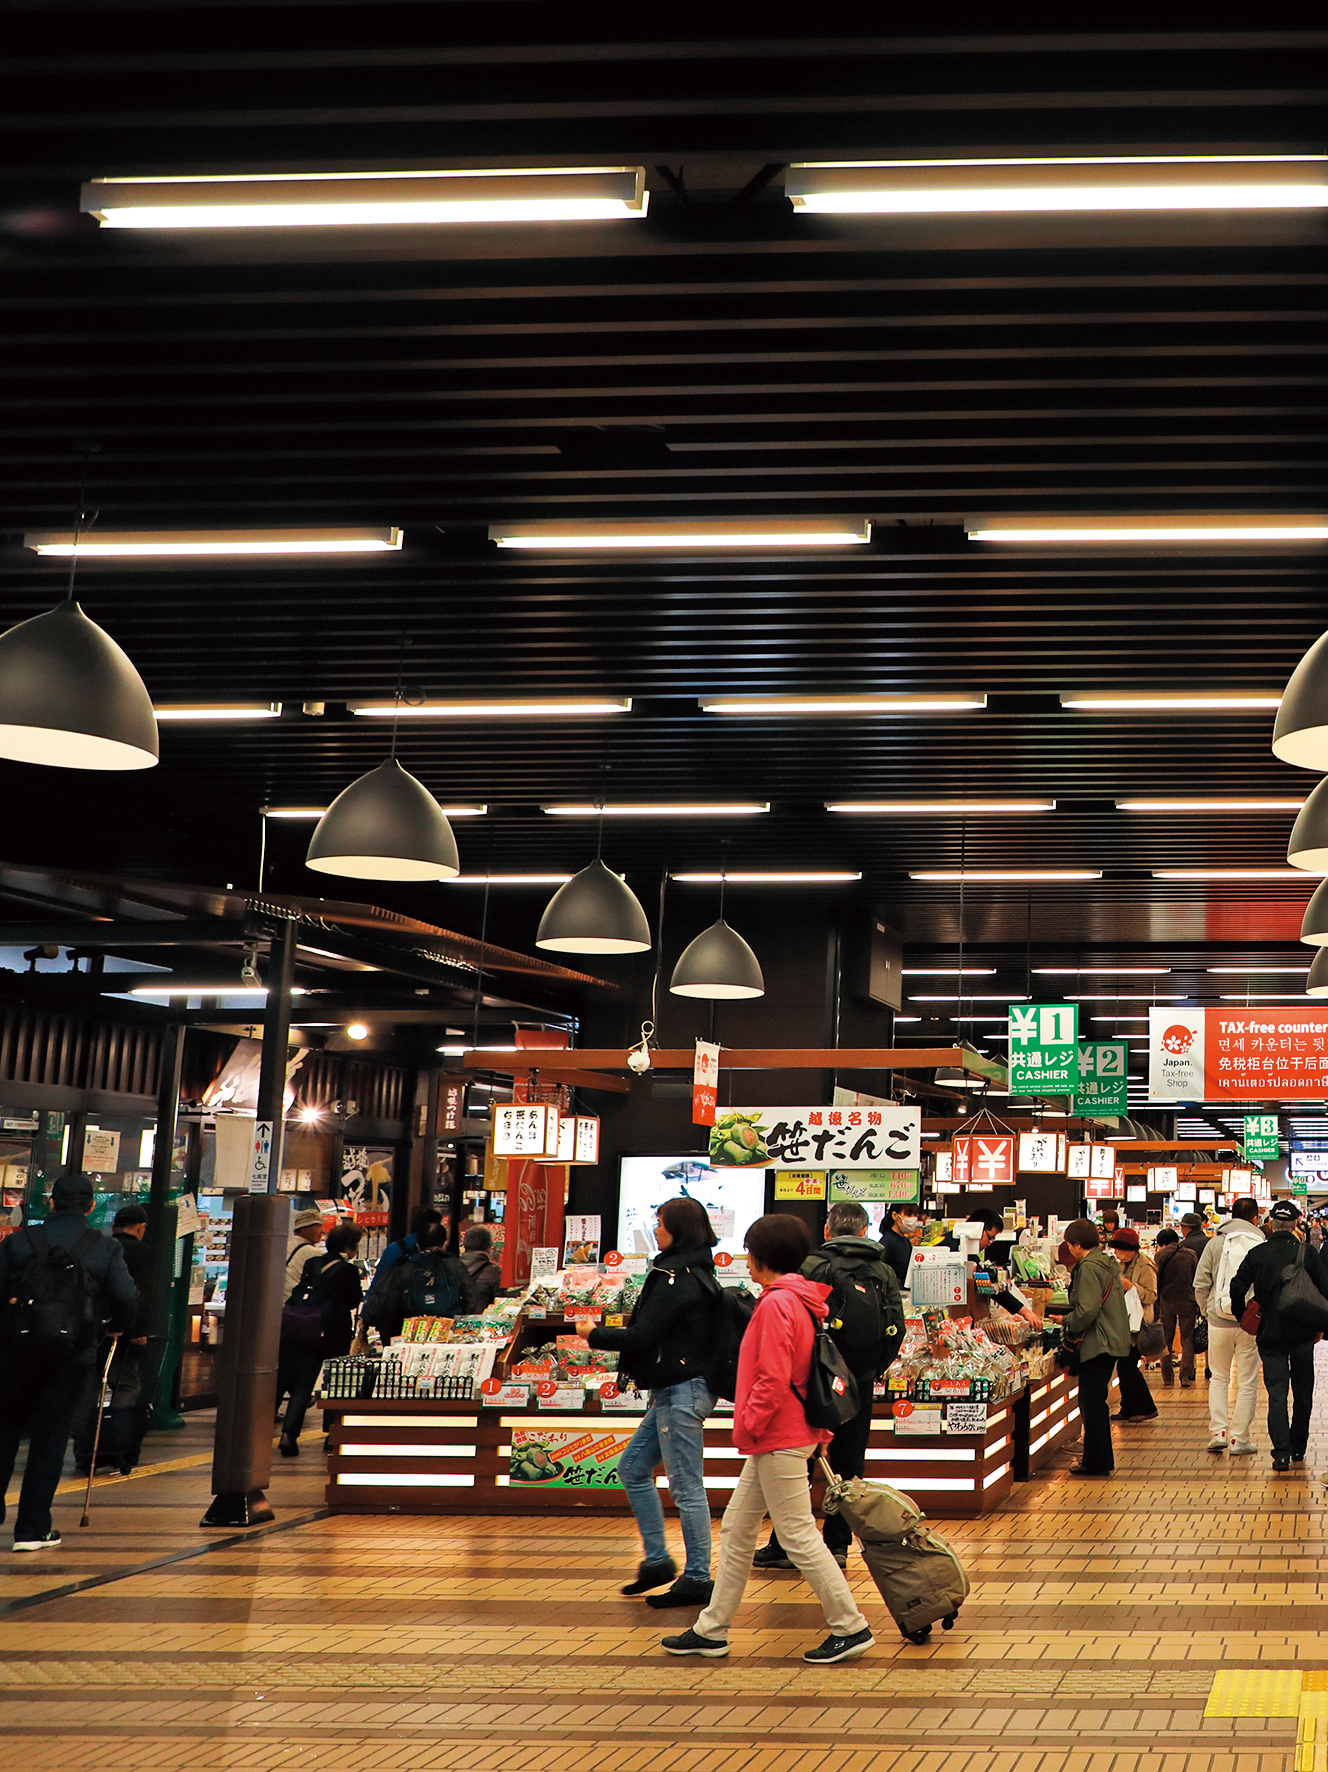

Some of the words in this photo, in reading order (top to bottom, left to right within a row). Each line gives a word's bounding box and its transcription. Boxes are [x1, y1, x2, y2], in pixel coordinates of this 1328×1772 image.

[1219, 1021, 1276, 1033] TAX-free
[1278, 1022, 1328, 1033] counter
[1218, 1037, 1245, 1051] 면세
[1251, 1037, 1307, 1051] 카운터는
[1011, 1050, 1074, 1068] 共通レジ
[1163, 1058, 1193, 1068] Japan.
[1016, 1070, 1068, 1080] CASHIER
[1161, 1069, 1194, 1077] Tax-free
[1166, 1079, 1188, 1088] Shop
[1077, 1096, 1119, 1105] CASHIER
[808, 1111, 883, 1126] 越後名物
[766, 1121, 915, 1163] 笹だんご
[1246, 1139, 1278, 1147] 共通レジ
[956, 1141, 969, 1180] ¥
[978, 1140, 1008, 1180] ¥
[1114, 1171, 1122, 1195] ¥
[609, 1253, 618, 1264] 2
[718, 1254, 726, 1265] 4
[541, 1384, 551, 1396] 2
[605, 1384, 614, 1397] 3
[898, 1403, 907, 1415] 7
[530, 1431, 568, 1442] こだわり
